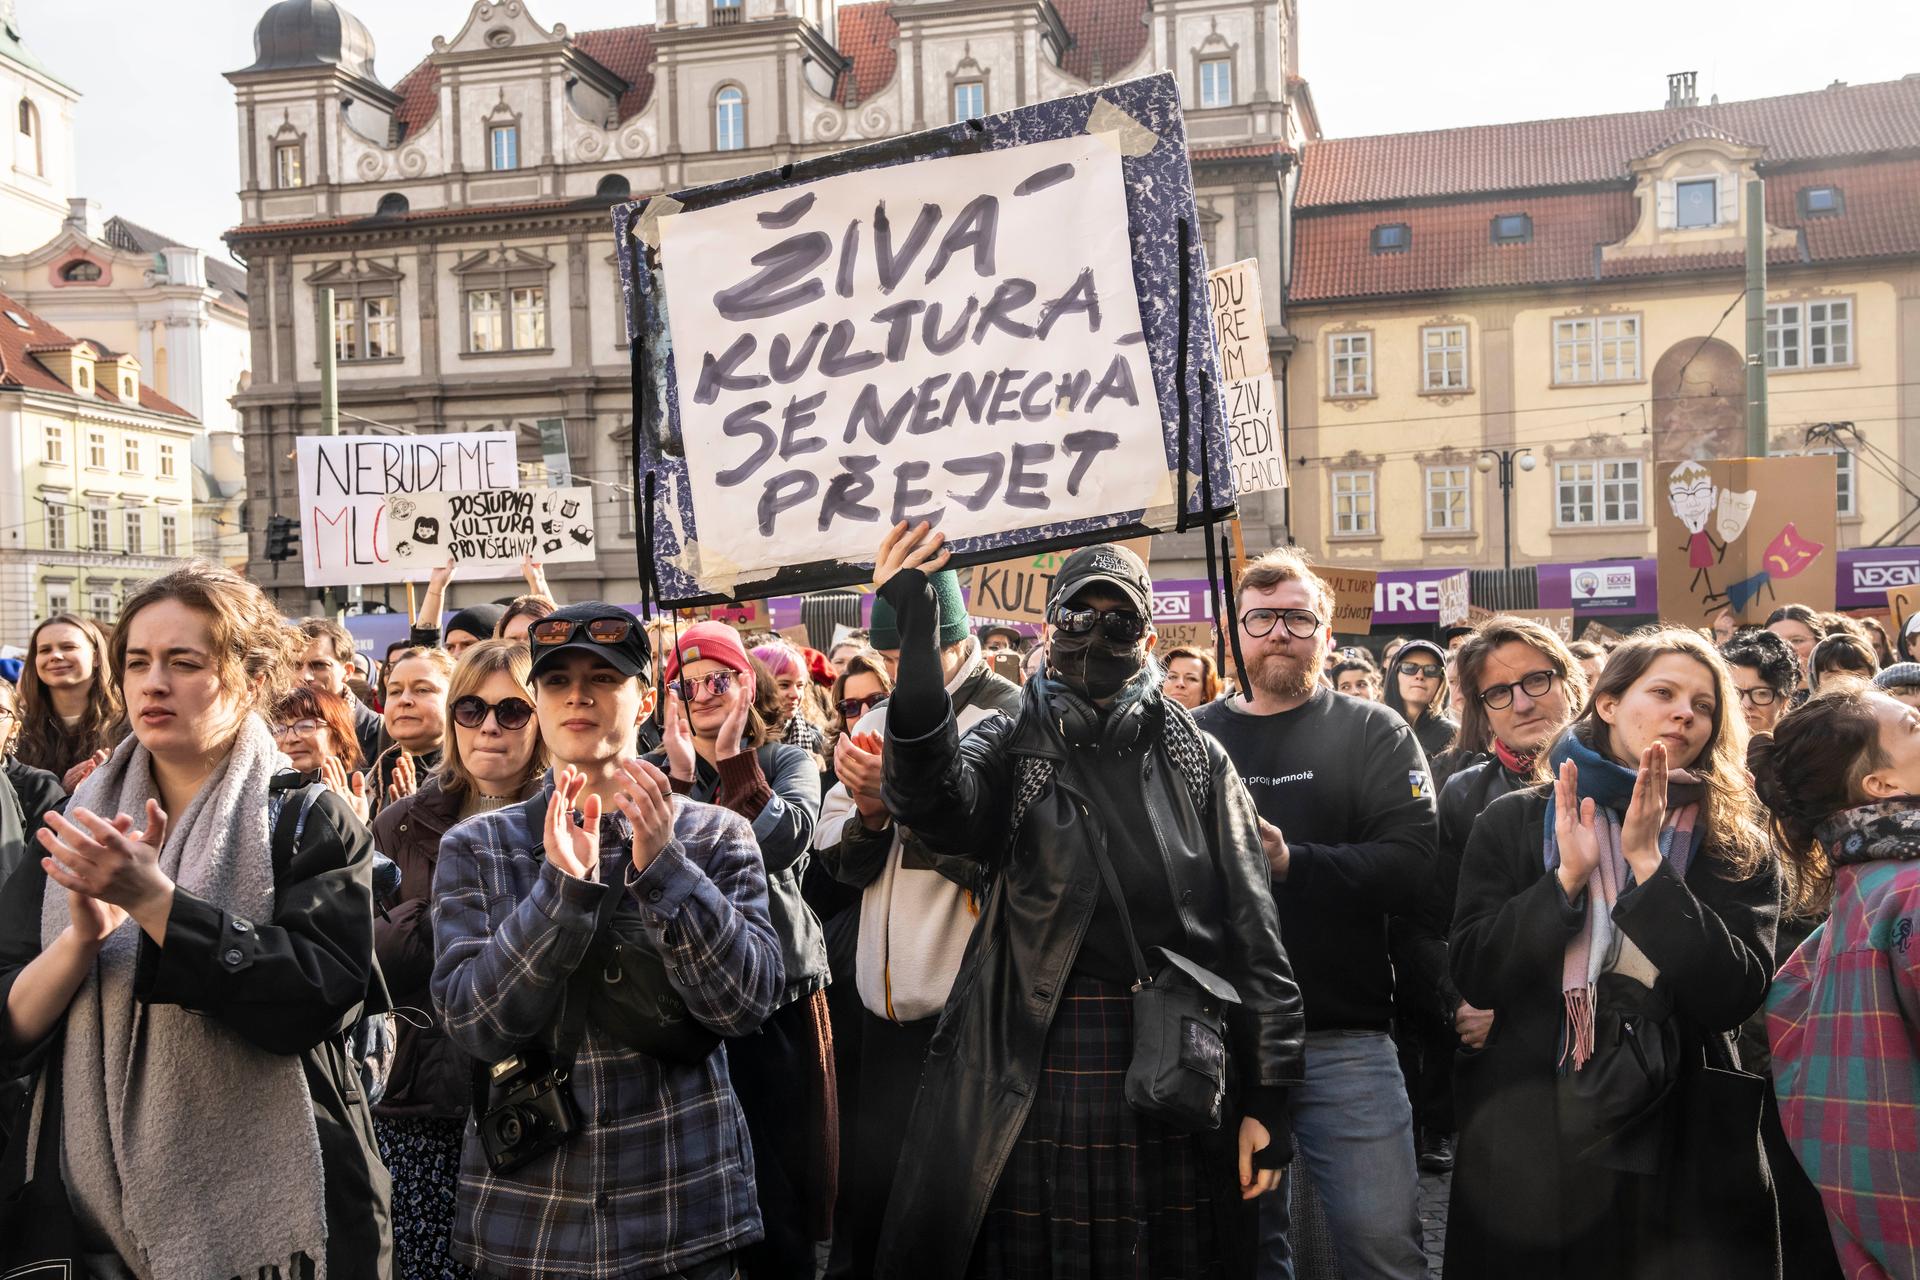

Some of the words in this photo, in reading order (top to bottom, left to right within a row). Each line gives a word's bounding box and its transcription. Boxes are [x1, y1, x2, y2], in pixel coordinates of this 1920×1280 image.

[713, 163, 1076, 322] ŽIVÁ
[693, 266, 1102, 405] KULTURA
[715, 391, 829, 487] SE
[843, 331, 1146, 445] NENECHÁ
[756, 429, 1119, 538] PŘEJET
[448, 490, 537, 521] DOSTUPNÁ
[450, 512, 535, 540] KULTURA
[448, 537, 476, 563] PRO
[977, 566, 1056, 615] KULT
[1326, 577, 1376, 593] ULTURY
[1335, 604, 1373, 620] UŠNOST
[1157, 625, 1197, 640] ULISY
[1272, 769, 1314, 787] temnotě
